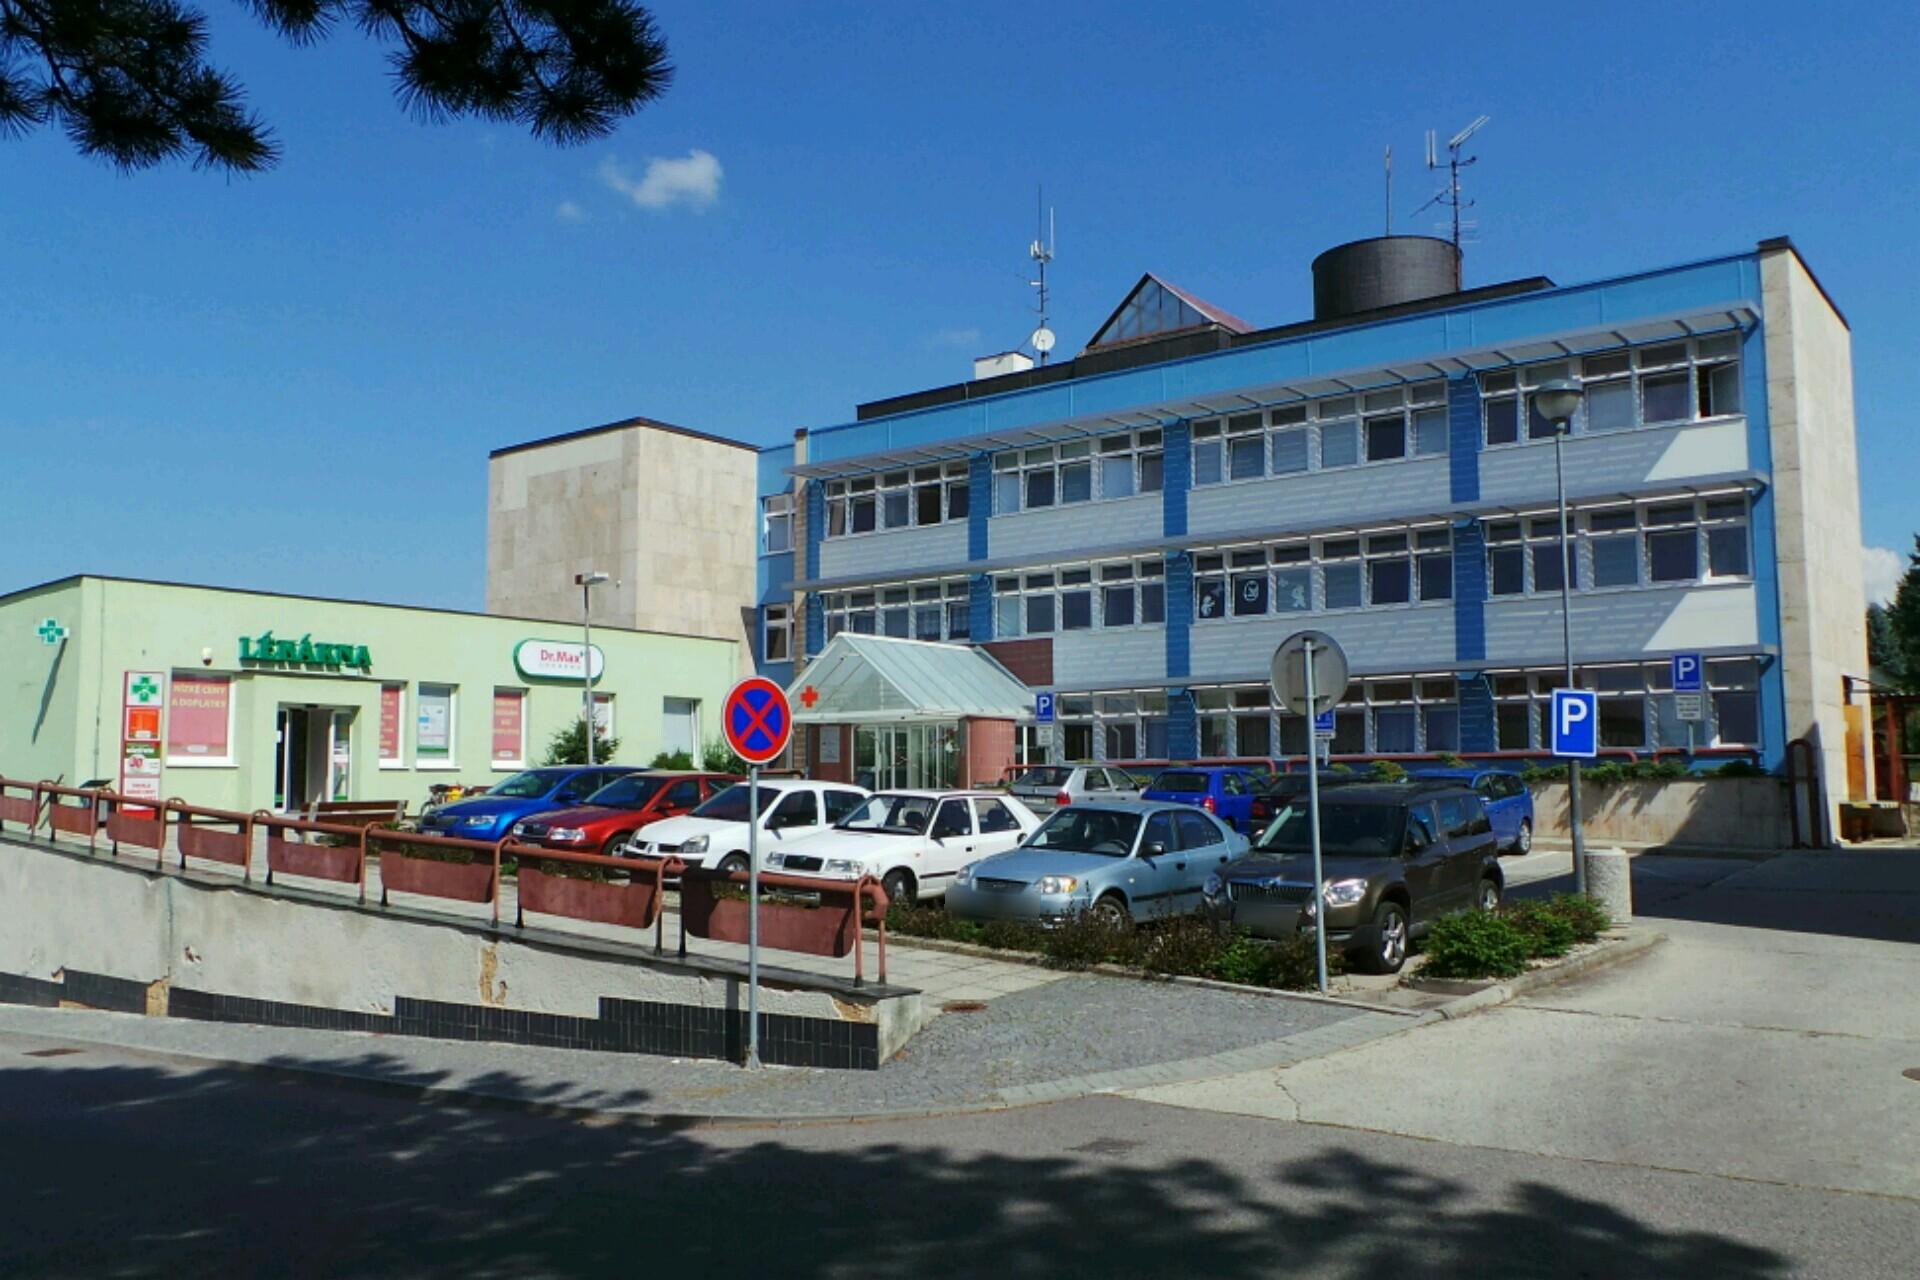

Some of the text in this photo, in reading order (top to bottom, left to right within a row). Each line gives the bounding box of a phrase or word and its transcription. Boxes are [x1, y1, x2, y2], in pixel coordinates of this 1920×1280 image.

[540, 649, 581, 664] Dr.Max
[1679, 657, 1696, 681] P
[1039, 696, 1050, 714] P
[1562, 697, 1587, 736] P
